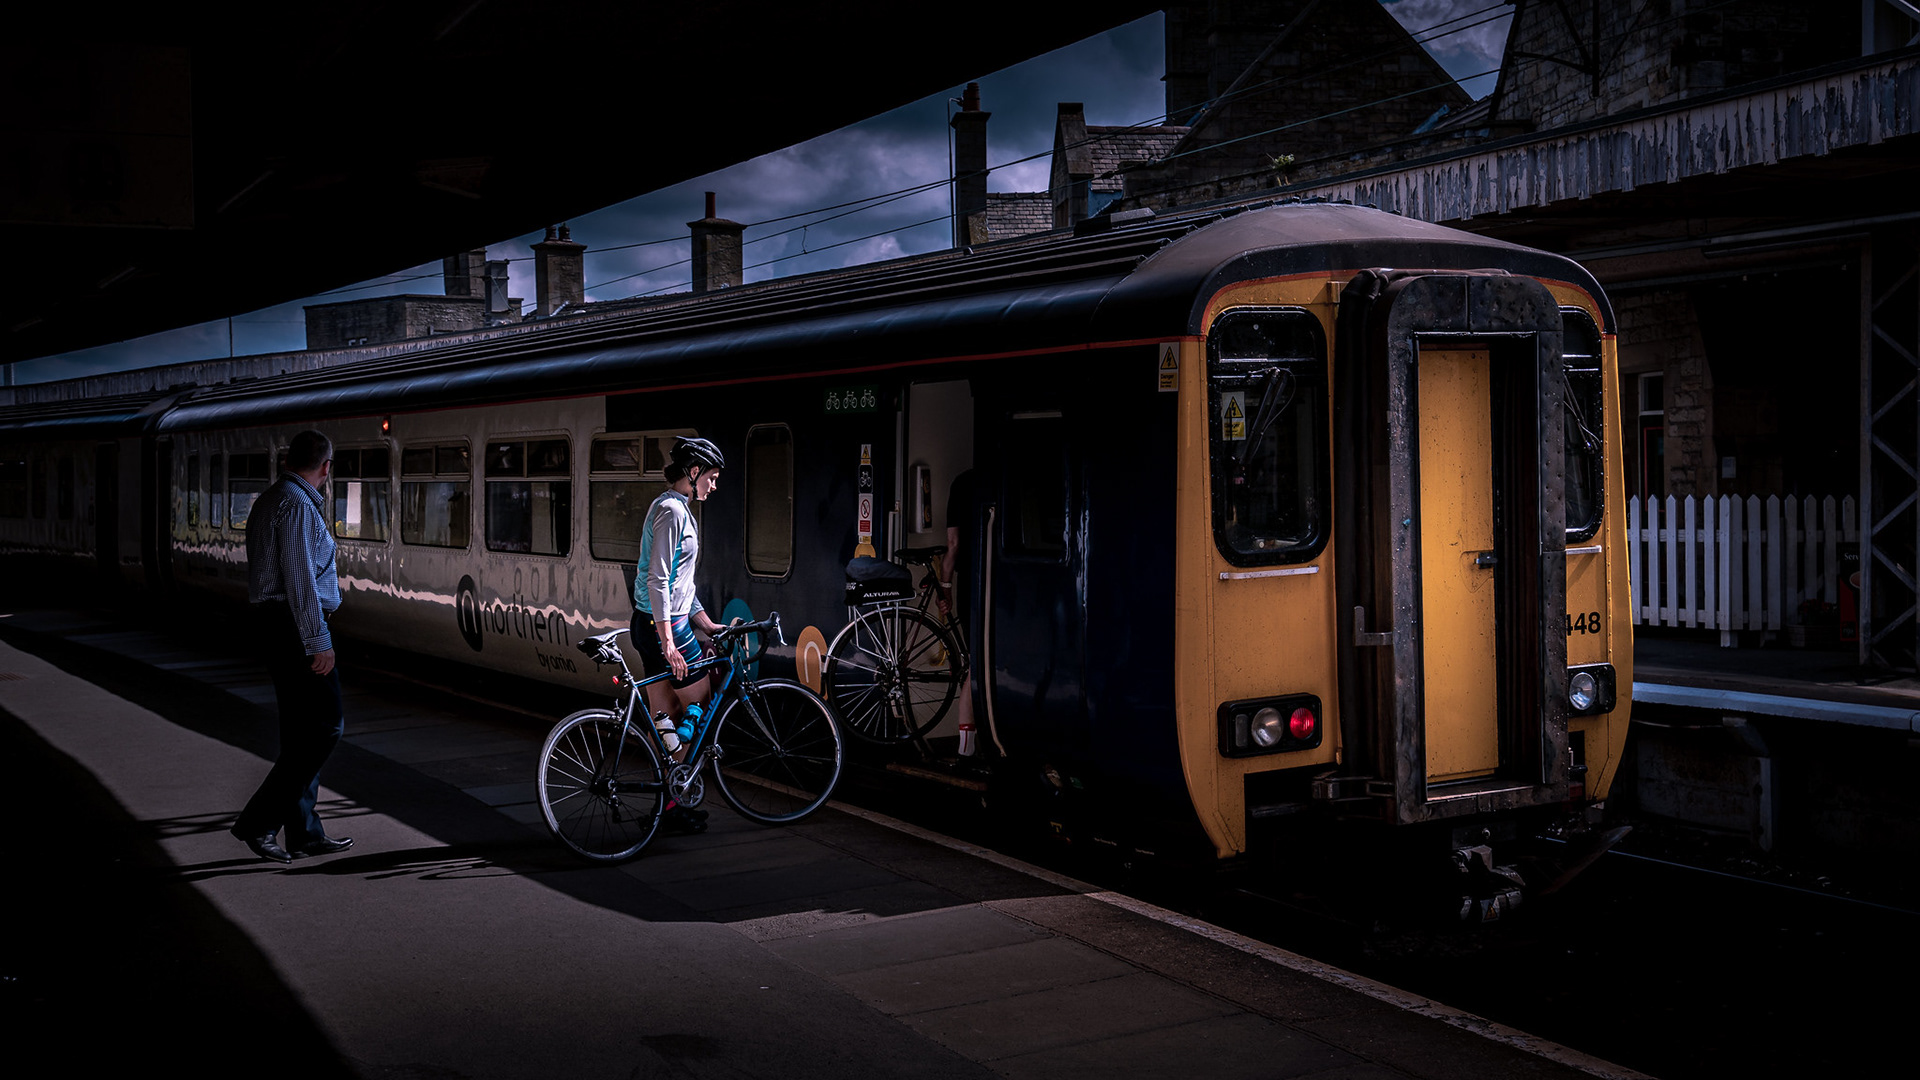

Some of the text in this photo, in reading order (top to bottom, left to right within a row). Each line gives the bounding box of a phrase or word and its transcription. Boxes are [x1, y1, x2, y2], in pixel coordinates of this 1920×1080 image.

[484, 593, 569, 646] northern
[535, 646, 577, 673] by arriva
